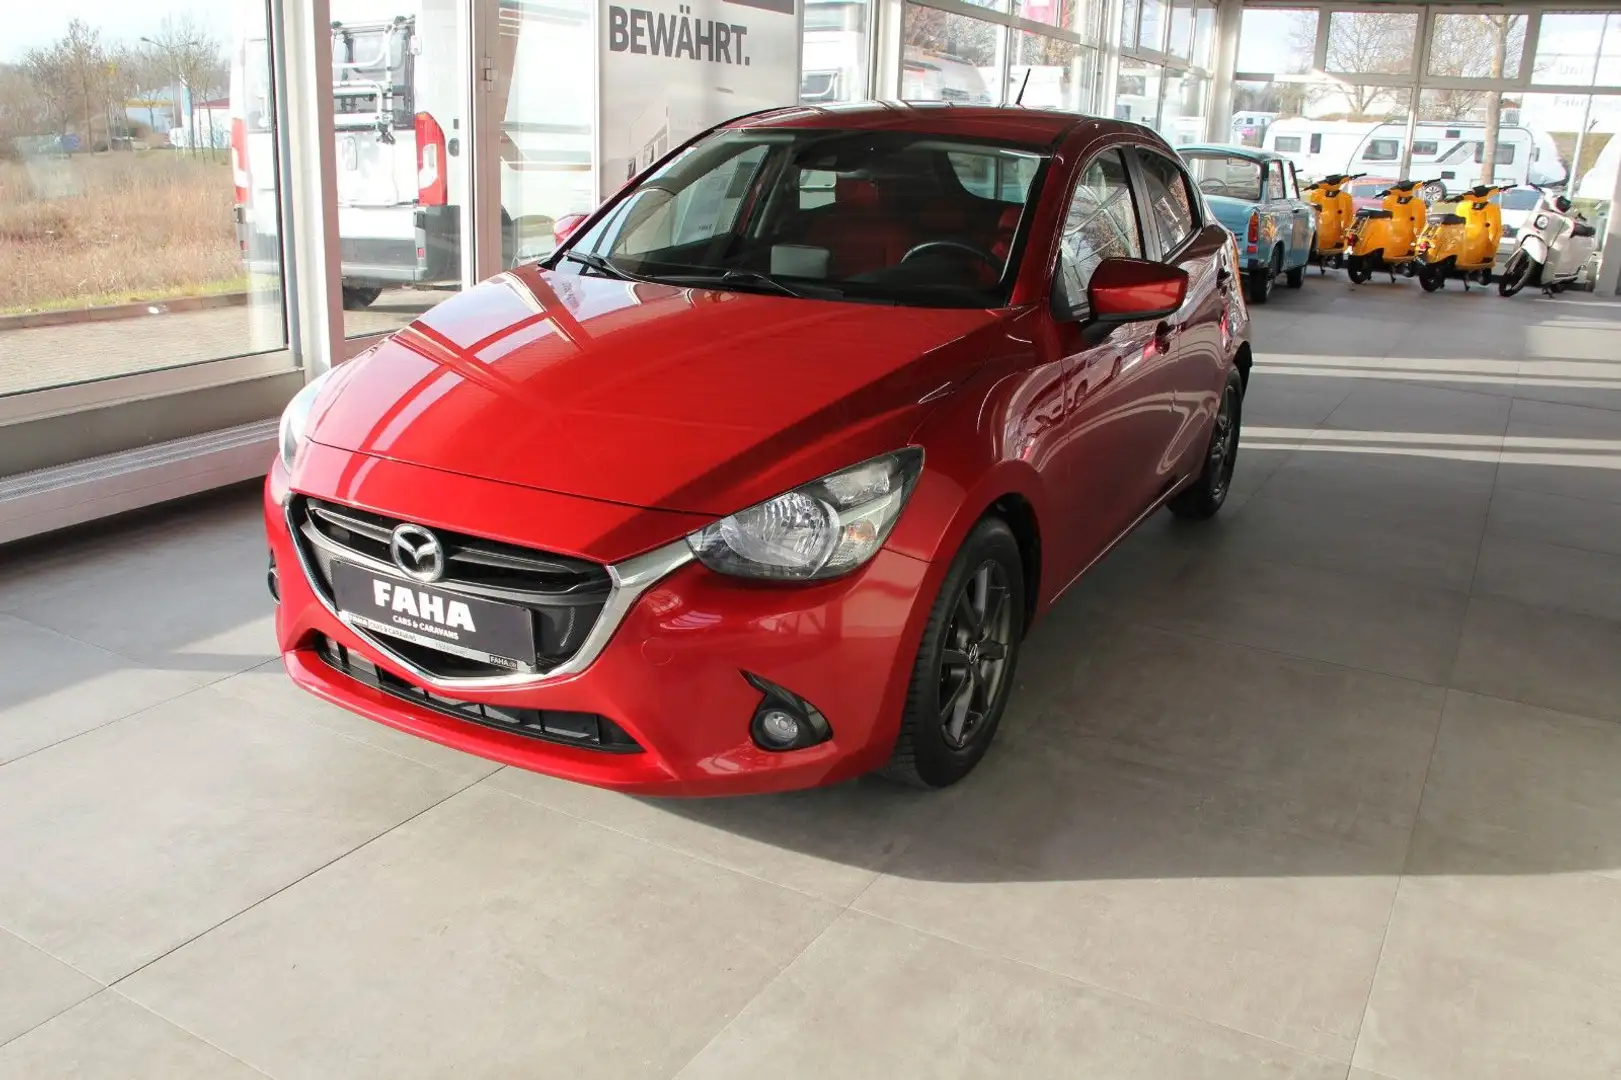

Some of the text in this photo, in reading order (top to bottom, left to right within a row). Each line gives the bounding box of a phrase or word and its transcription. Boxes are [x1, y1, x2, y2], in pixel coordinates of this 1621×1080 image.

[609, 4, 750, 66] BEWÄHRT.
[373, 579, 476, 632] FAHA
[392, 614, 413, 627] CARS
[419, 622, 459, 640] CARAVANS
